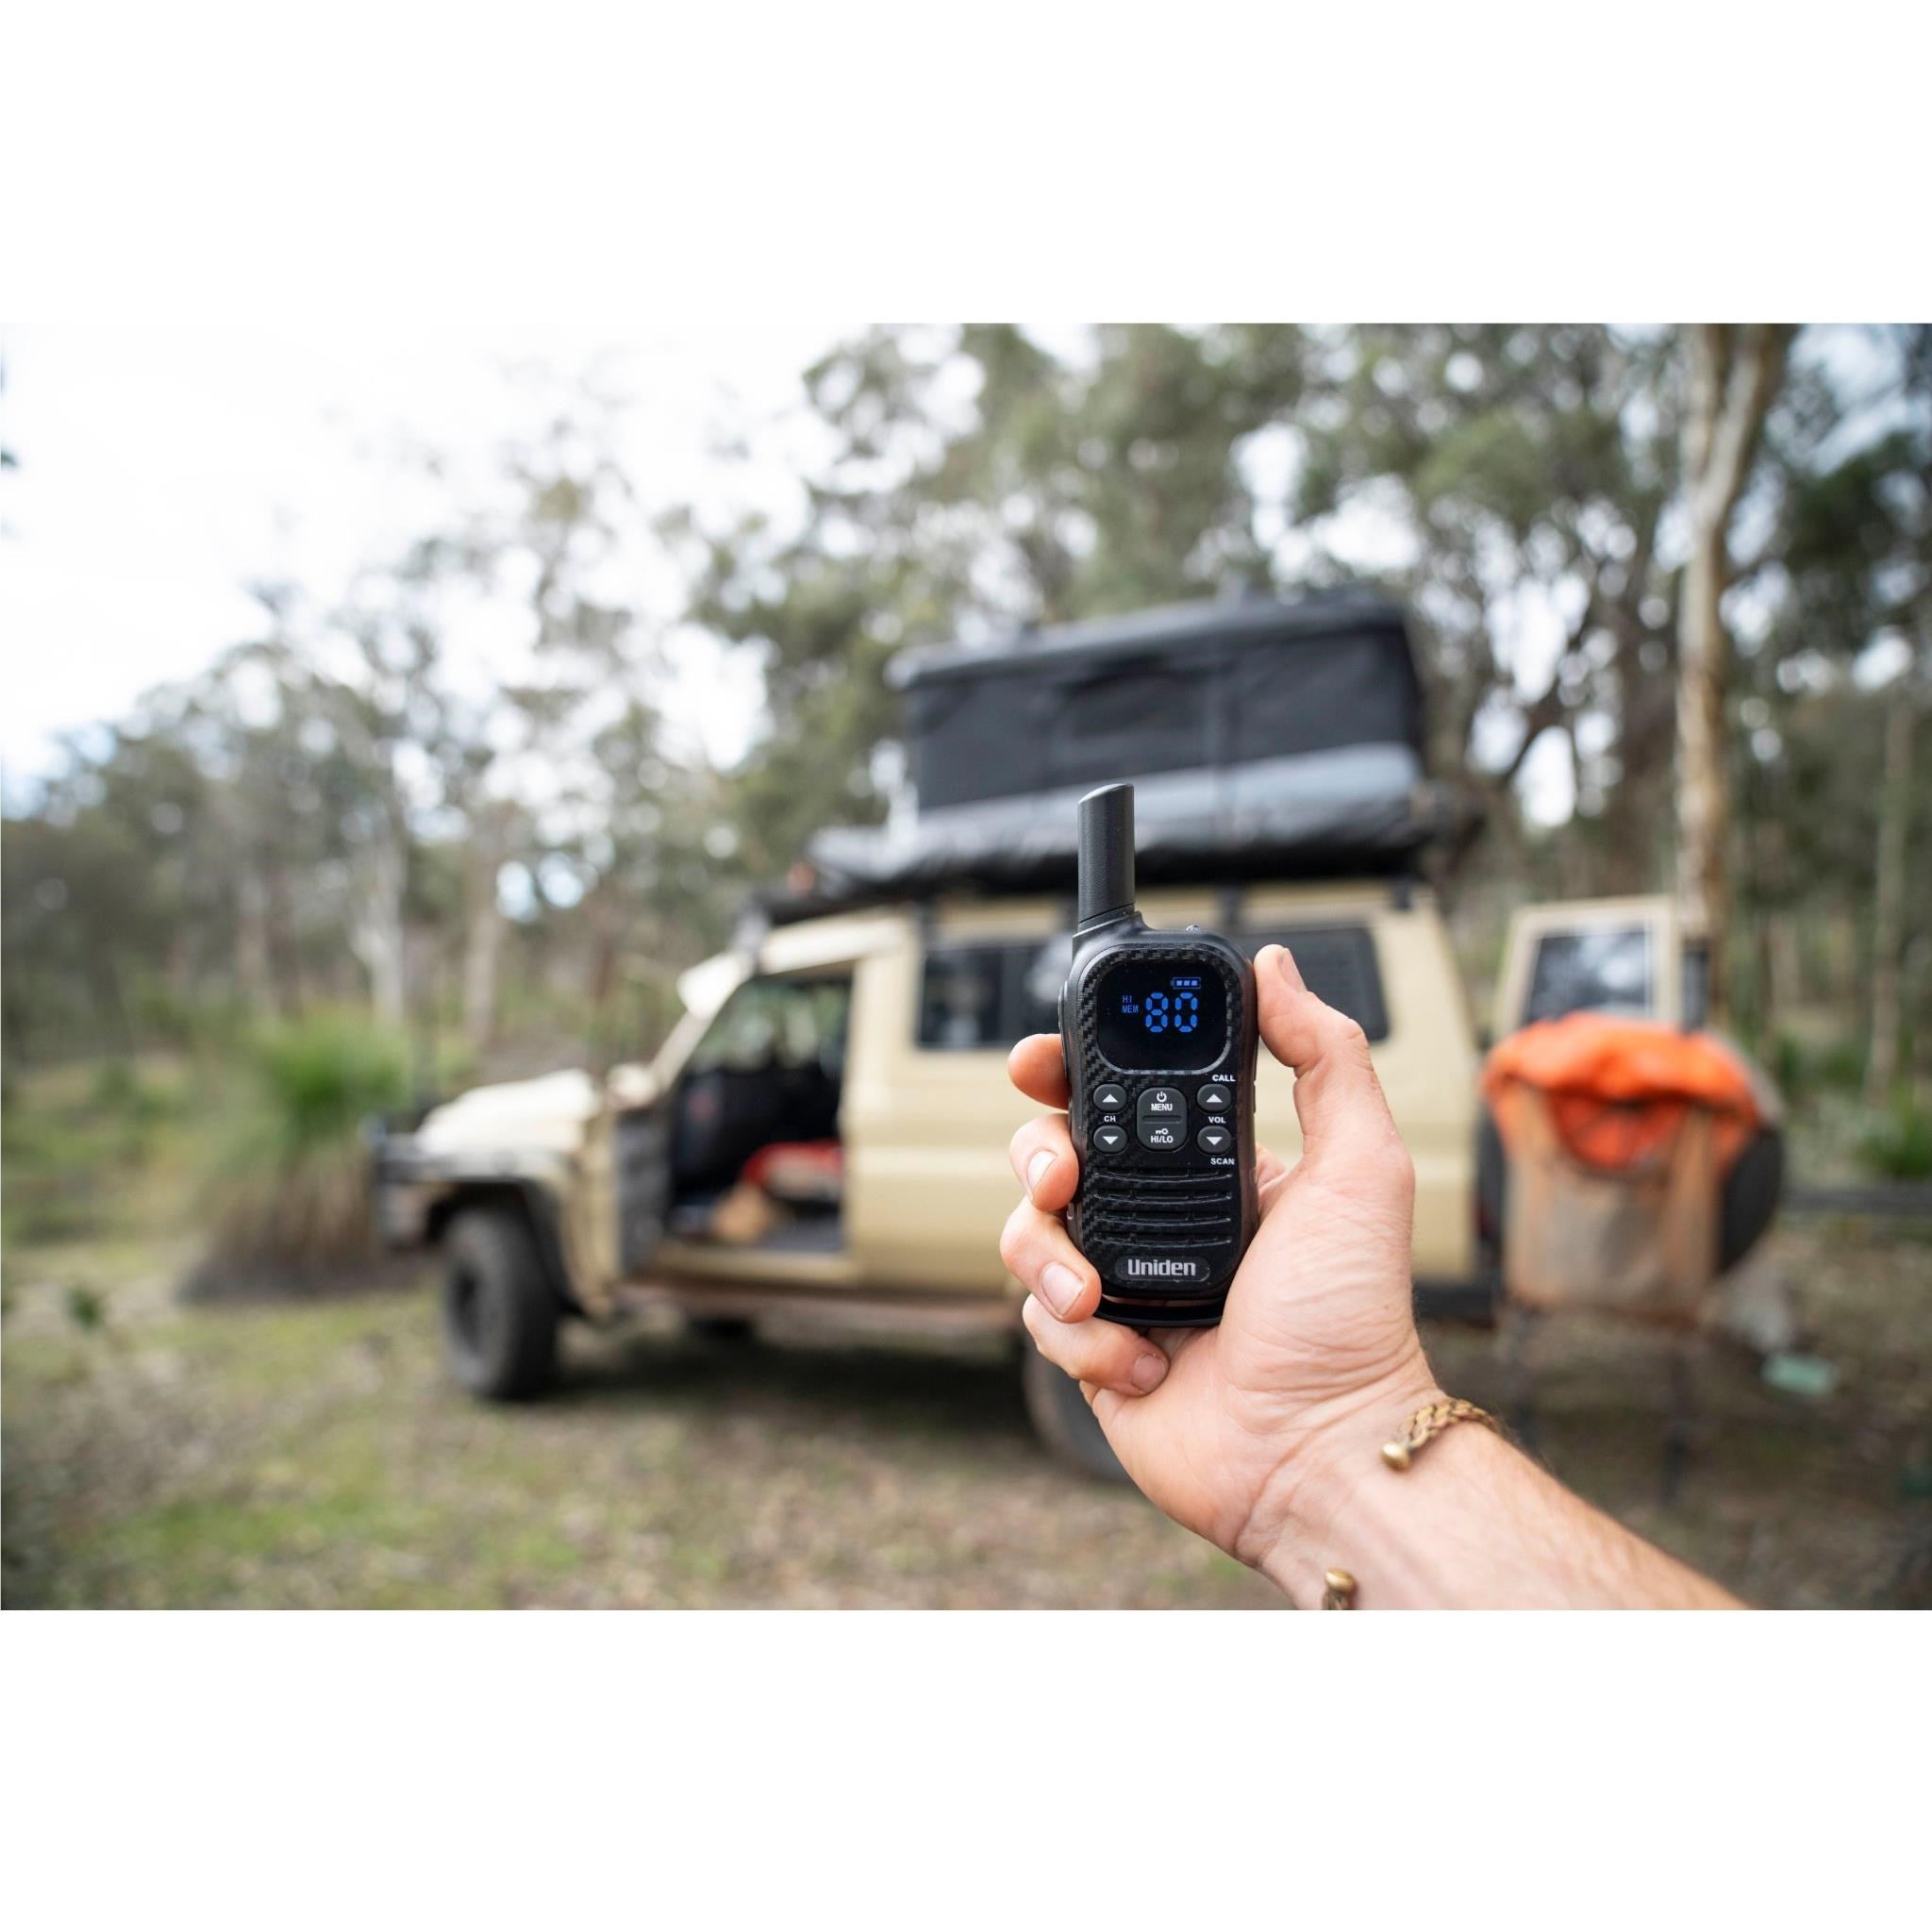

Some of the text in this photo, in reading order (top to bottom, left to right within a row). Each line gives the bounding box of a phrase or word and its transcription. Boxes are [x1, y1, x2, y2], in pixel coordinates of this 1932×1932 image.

[1122, 994, 1133, 1004] HI
[1122, 1004, 1139, 1014] MEM
[1145, 991, 1198, 1033] 80
[1211, 1074, 1236, 1082] CALL
[1150, 1103, 1174, 1111] MENU
[1150, 1134, 1174, 1143] HI/LO
[1210, 1158, 1235, 1166] SCAN
[1127, 1258, 1196, 1276] Uniden
